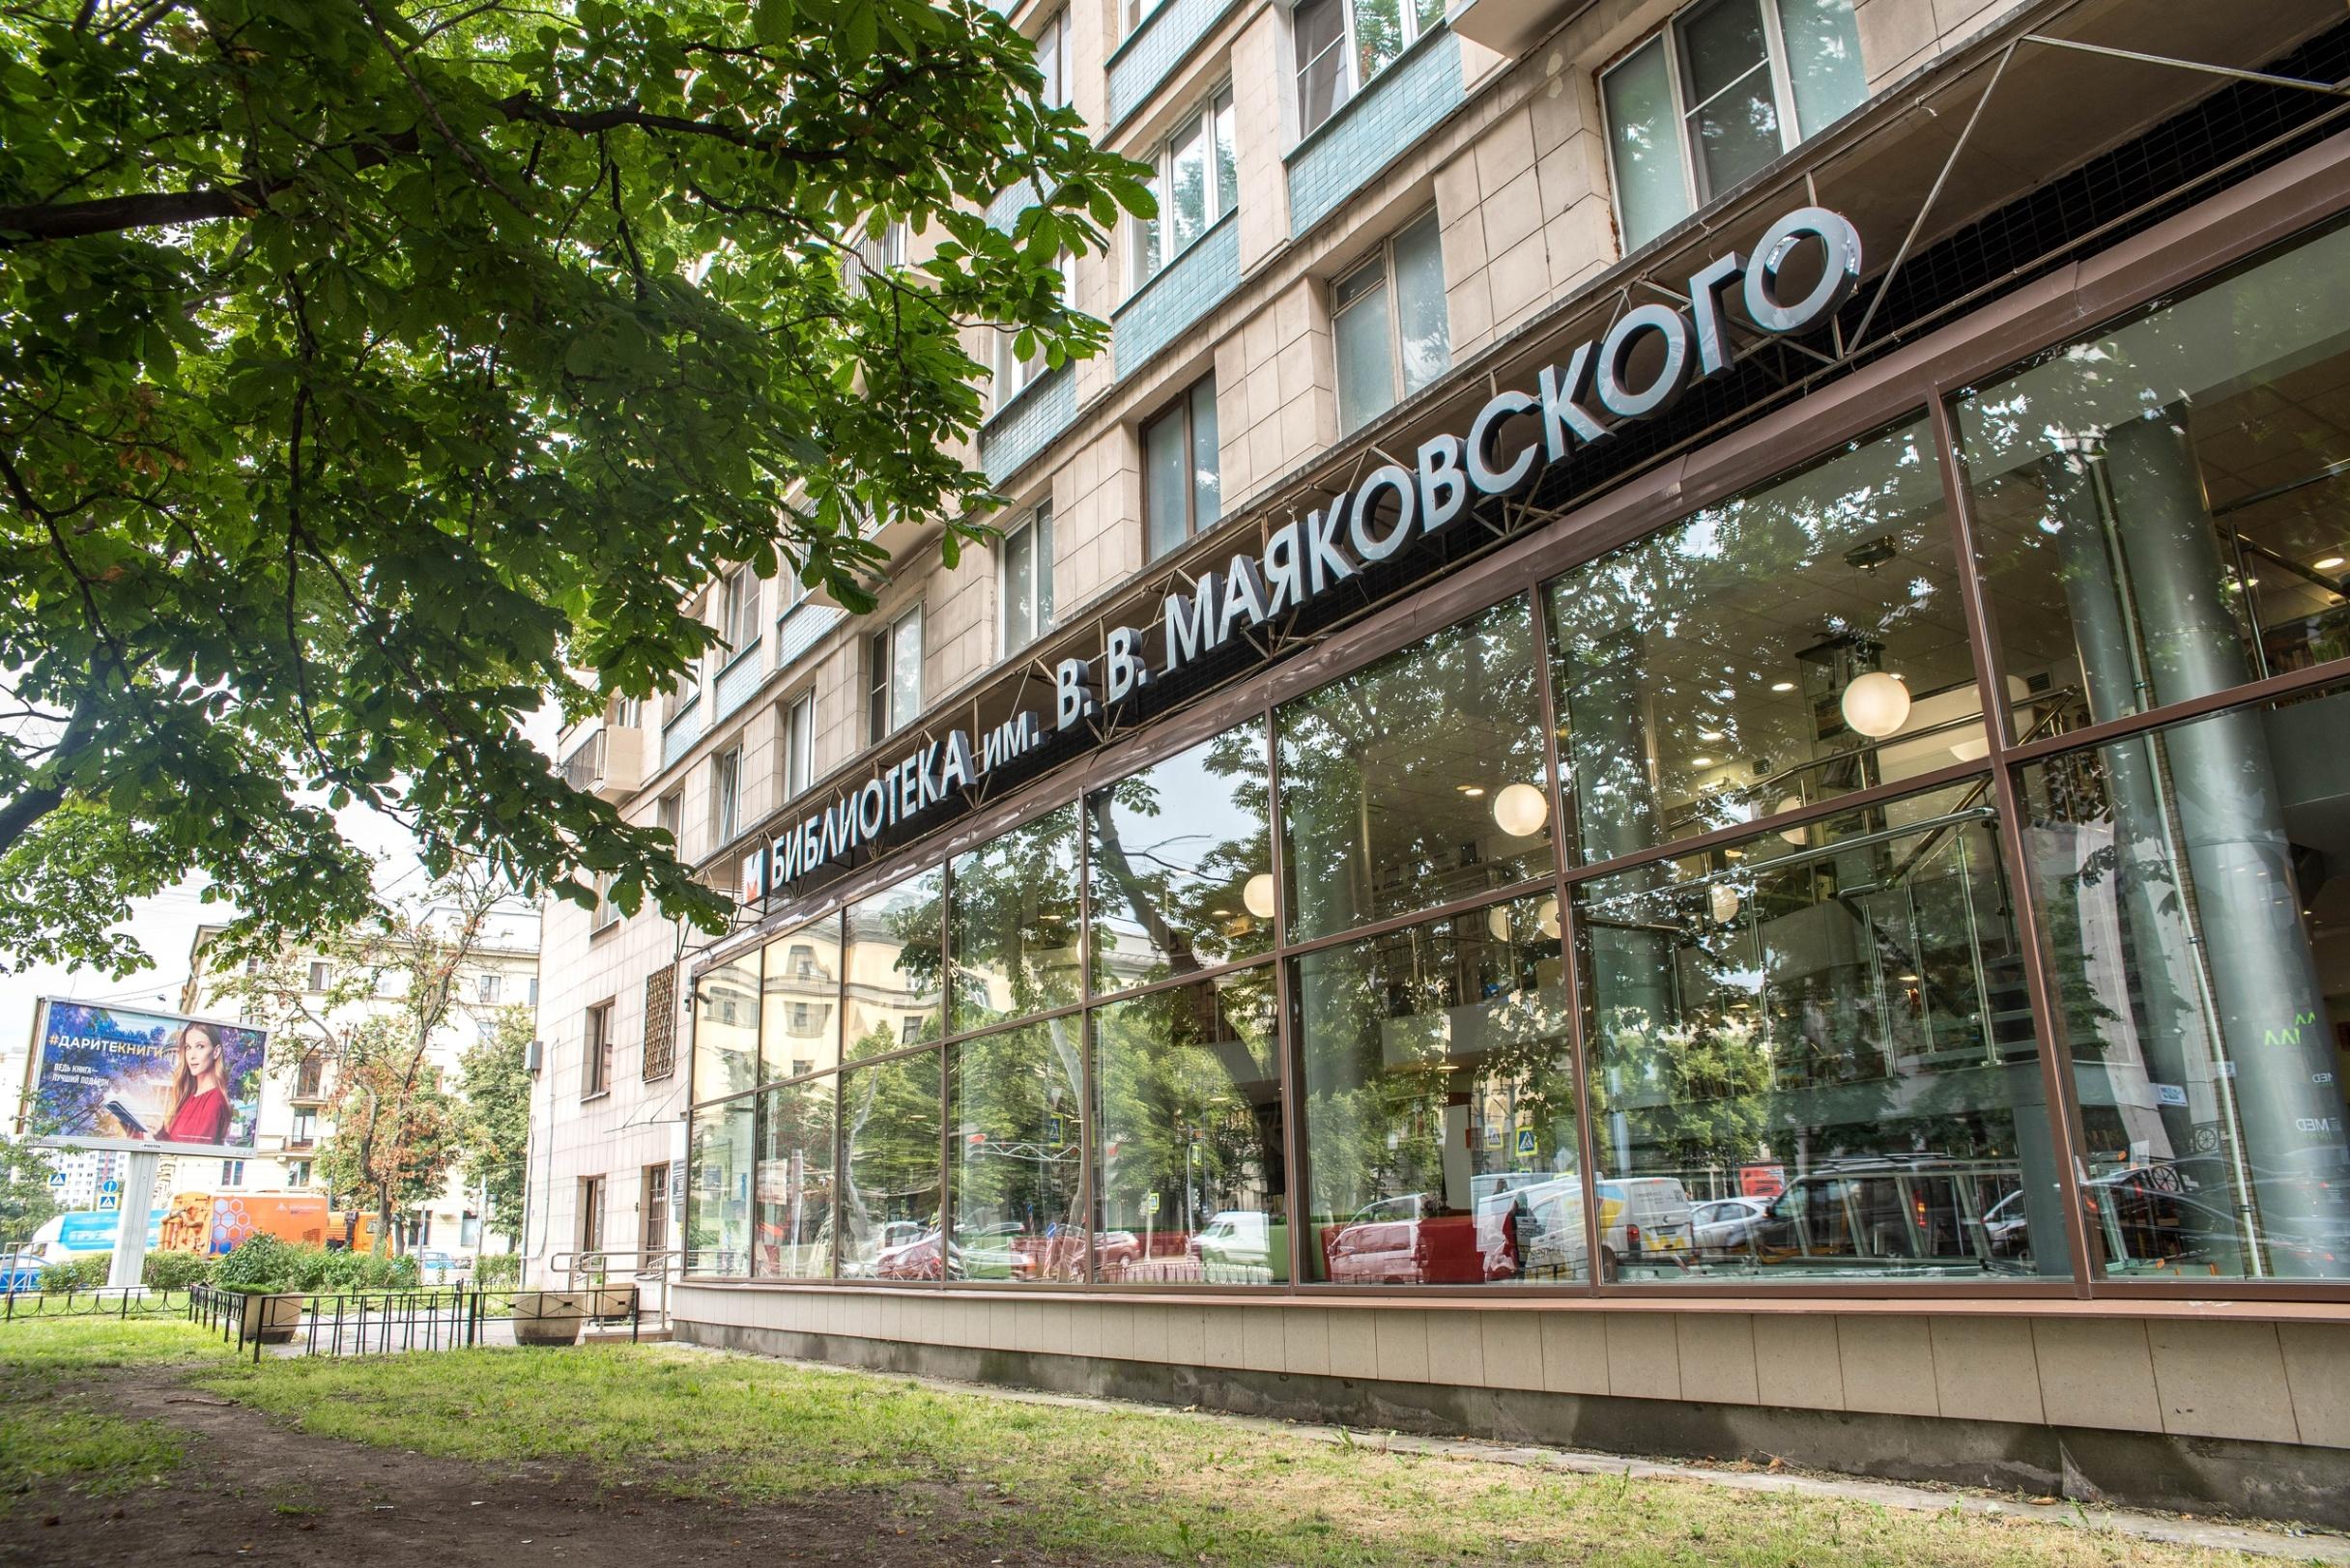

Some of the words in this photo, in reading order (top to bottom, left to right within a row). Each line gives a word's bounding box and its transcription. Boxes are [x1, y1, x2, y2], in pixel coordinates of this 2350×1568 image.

[772, 729, 977, 891] БИБЛИОТЕКА
[983, 711, 1041, 772] им.
[1057, 658, 1093, 731] В.
[1107, 626, 1148, 703] В.
[1164, 207, 1863, 671] МАЯКОВСКОГО
[49, 1035, 163, 1057] #ДАРИТЕКНИГИ
[54, 1064, 71, 1072] ВЕДЬ
[52, 1073, 79, 1084] ЛУЧШИЙ
[81, 1076, 109, 1087] ПОДАРОК
